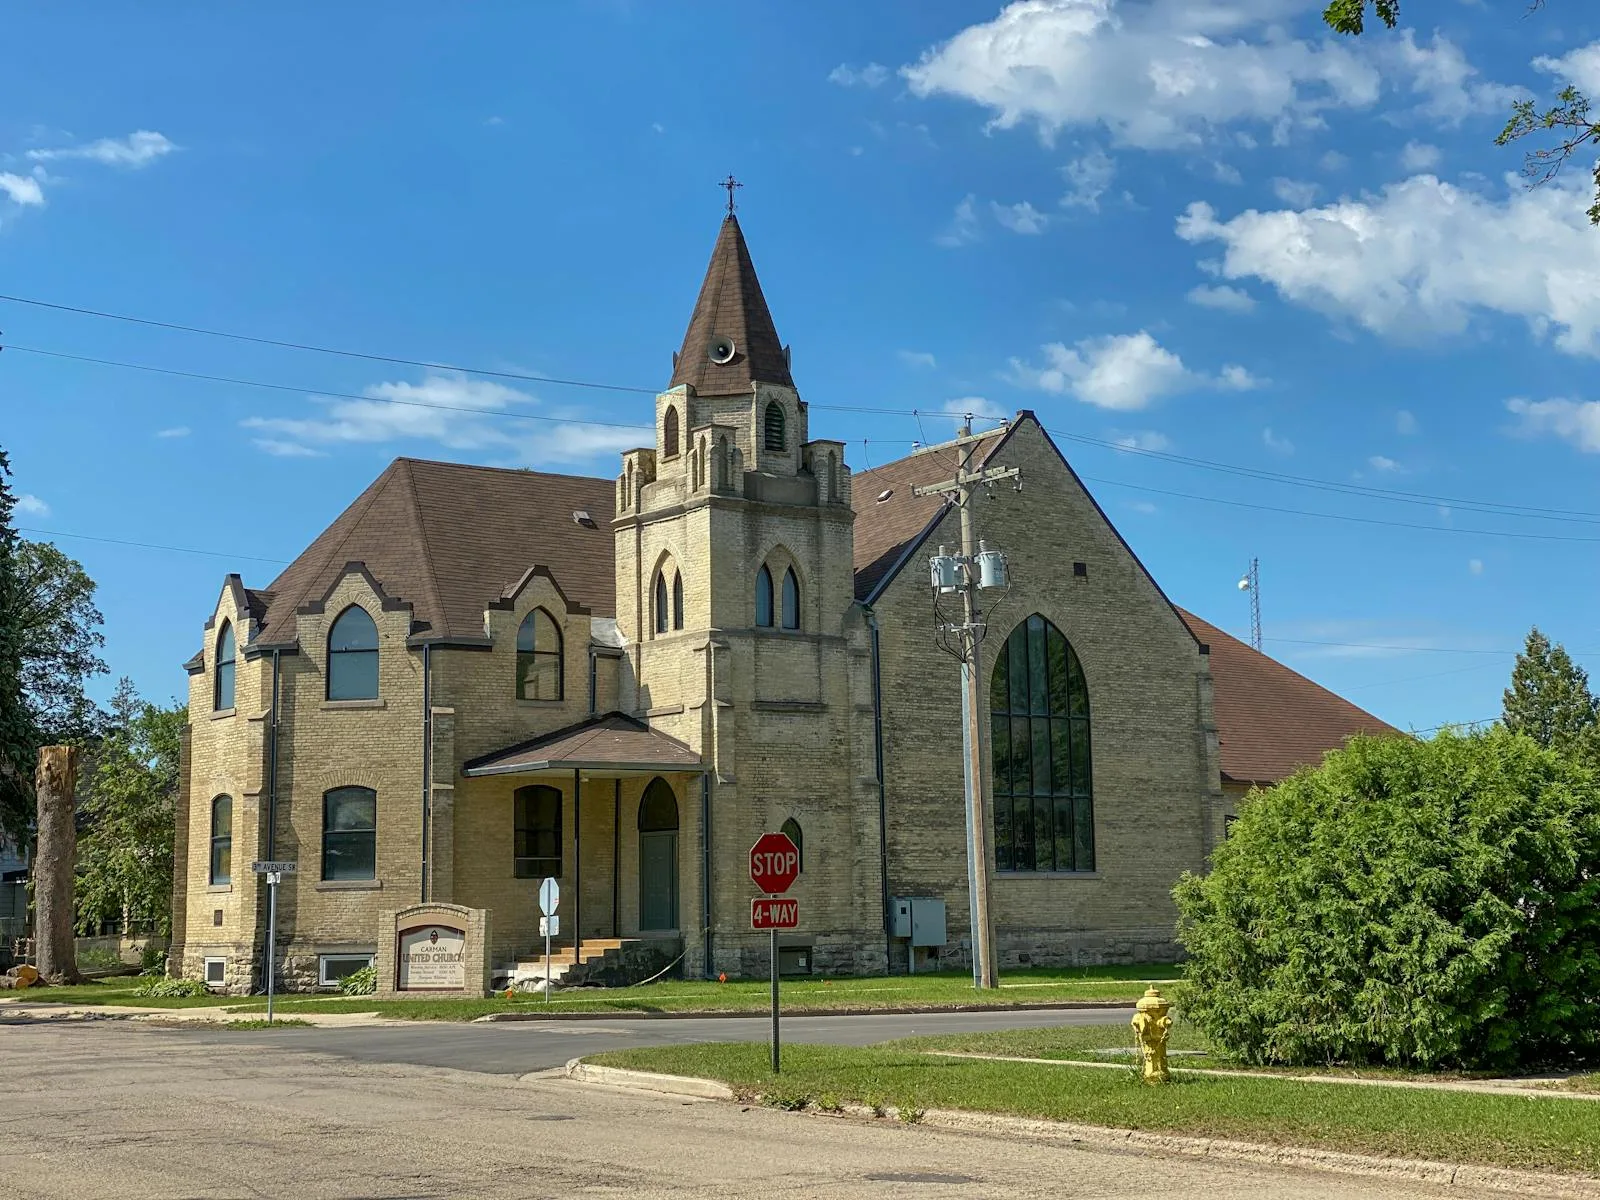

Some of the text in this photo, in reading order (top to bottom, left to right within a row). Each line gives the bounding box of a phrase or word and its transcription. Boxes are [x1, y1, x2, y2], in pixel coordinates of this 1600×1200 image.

[263, 863, 286, 871] AVENUE
[753, 852, 796, 876] STOP
[753, 904, 797, 925] 4-WAY
[402, 953, 465, 963] UNITED CHURCH
